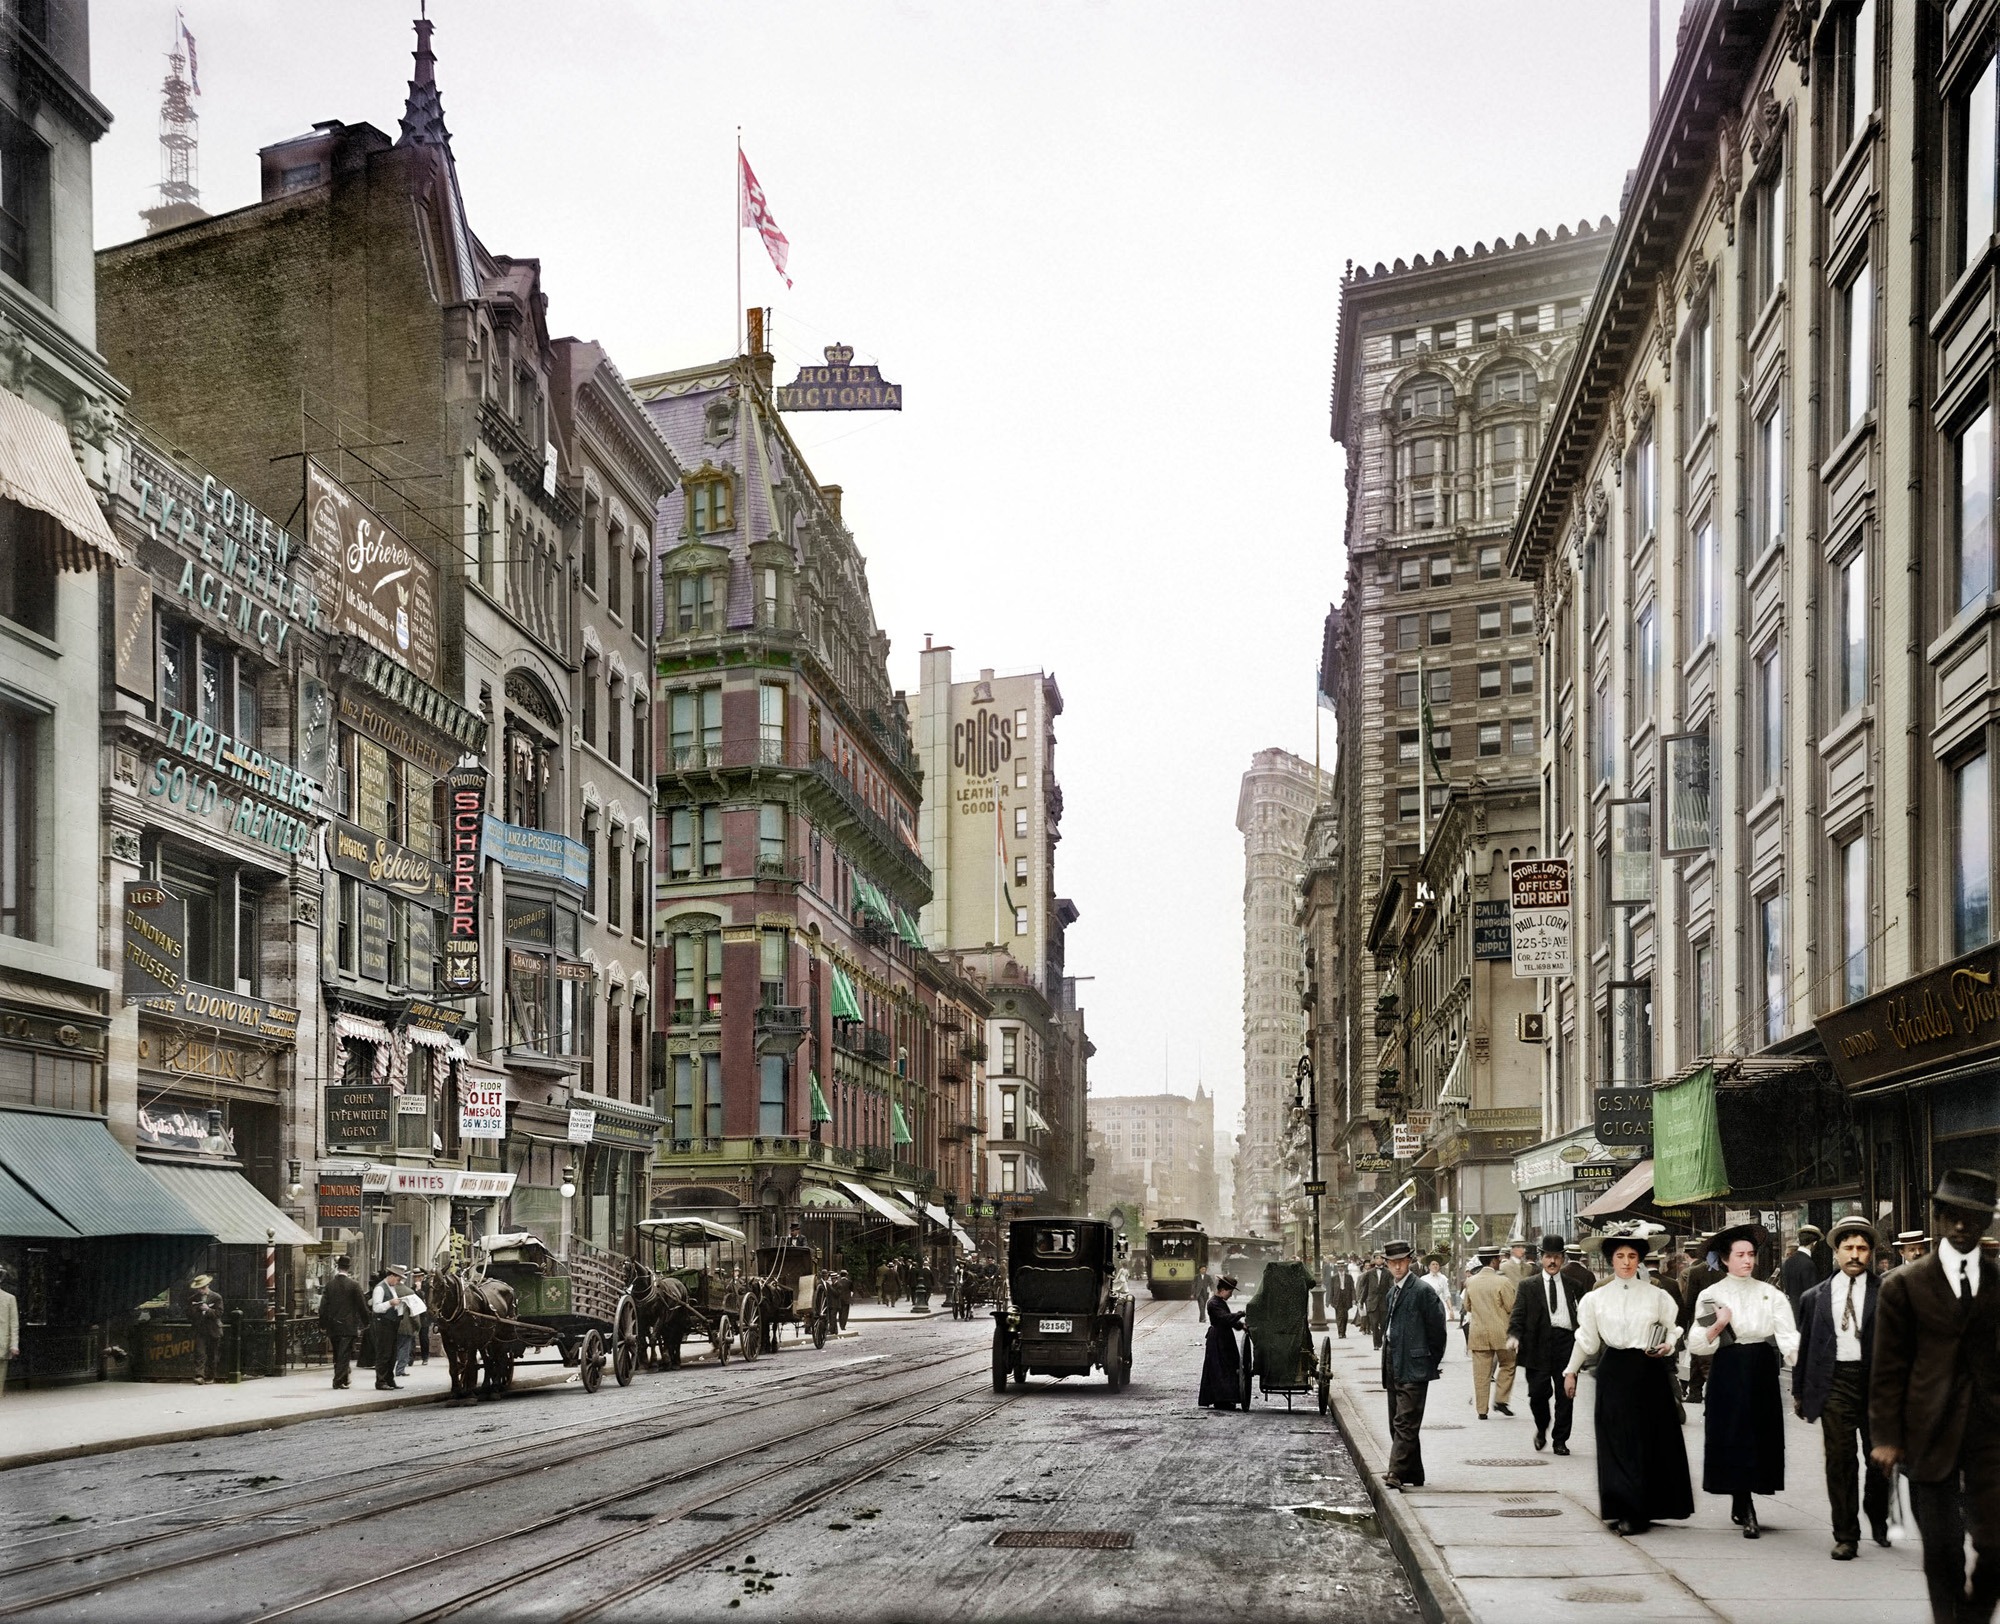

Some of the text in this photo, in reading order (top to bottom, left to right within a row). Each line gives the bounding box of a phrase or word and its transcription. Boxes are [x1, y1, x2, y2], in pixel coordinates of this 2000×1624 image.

[801, 368, 876, 383] HOTEL
[778, 387, 899, 407] VICTORIA
[203, 474, 289, 566] COHEN
[137, 477, 320, 632] TYPEWRITER
[347, 519, 412, 574] Scherer
[178, 560, 289, 653] AGENCY
[341, 697, 437, 770] 1162 FOTOGRAFER
[955, 708, 1011, 778] CROSS
[150, 757, 218, 817] SOLD
[450, 773, 486, 788] PHOTOS
[957, 784, 1009, 801] LEATHR
[234, 796, 308, 854] RENTED
[505, 828, 521, 846] LANZ
[370, 839, 431, 881] Scherer
[452, 790, 480, 934] SCHERER
[1541, 862, 1568, 880] LOFTS
[1518, 880, 1563, 892] OFFICES
[129, 891, 165, 904] 1164
[1513, 891, 1568, 905] FOR RENT
[1475, 902, 1500, 917] EMIL
[362, 908, 386, 932] LATEST
[507, 908, 547, 933] PORTRAITS
[1514, 917, 1536, 933] PAUL
[1545, 915, 1569, 931] CORN
[126, 909, 182, 958] DONOVAN'S
[446, 940, 478, 953] STUDIO
[1476, 940, 1508, 953] SUPPLY
[125, 940, 179, 990] TRUSSES
[513, 954, 541, 971] CRAYONS
[481, 1081, 502, 1091] FLOOR
[344, 1094, 374, 1105] COHEN
[469, 1092, 502, 1105] O LET
[330, 1109, 388, 1121] TYPEWRITER
[463, 1119, 473, 1128] 26
[1418, 1116, 1432, 1125] LET
[341, 1126, 378, 1137] AGENCY
[1577, 1167, 1612, 1178] KODAKS
[320, 1184, 361, 1196] DONOVAN'S
[398, 1175, 445, 1190] WHITE'S
[320, 1206, 360, 1218] TRUSSES
